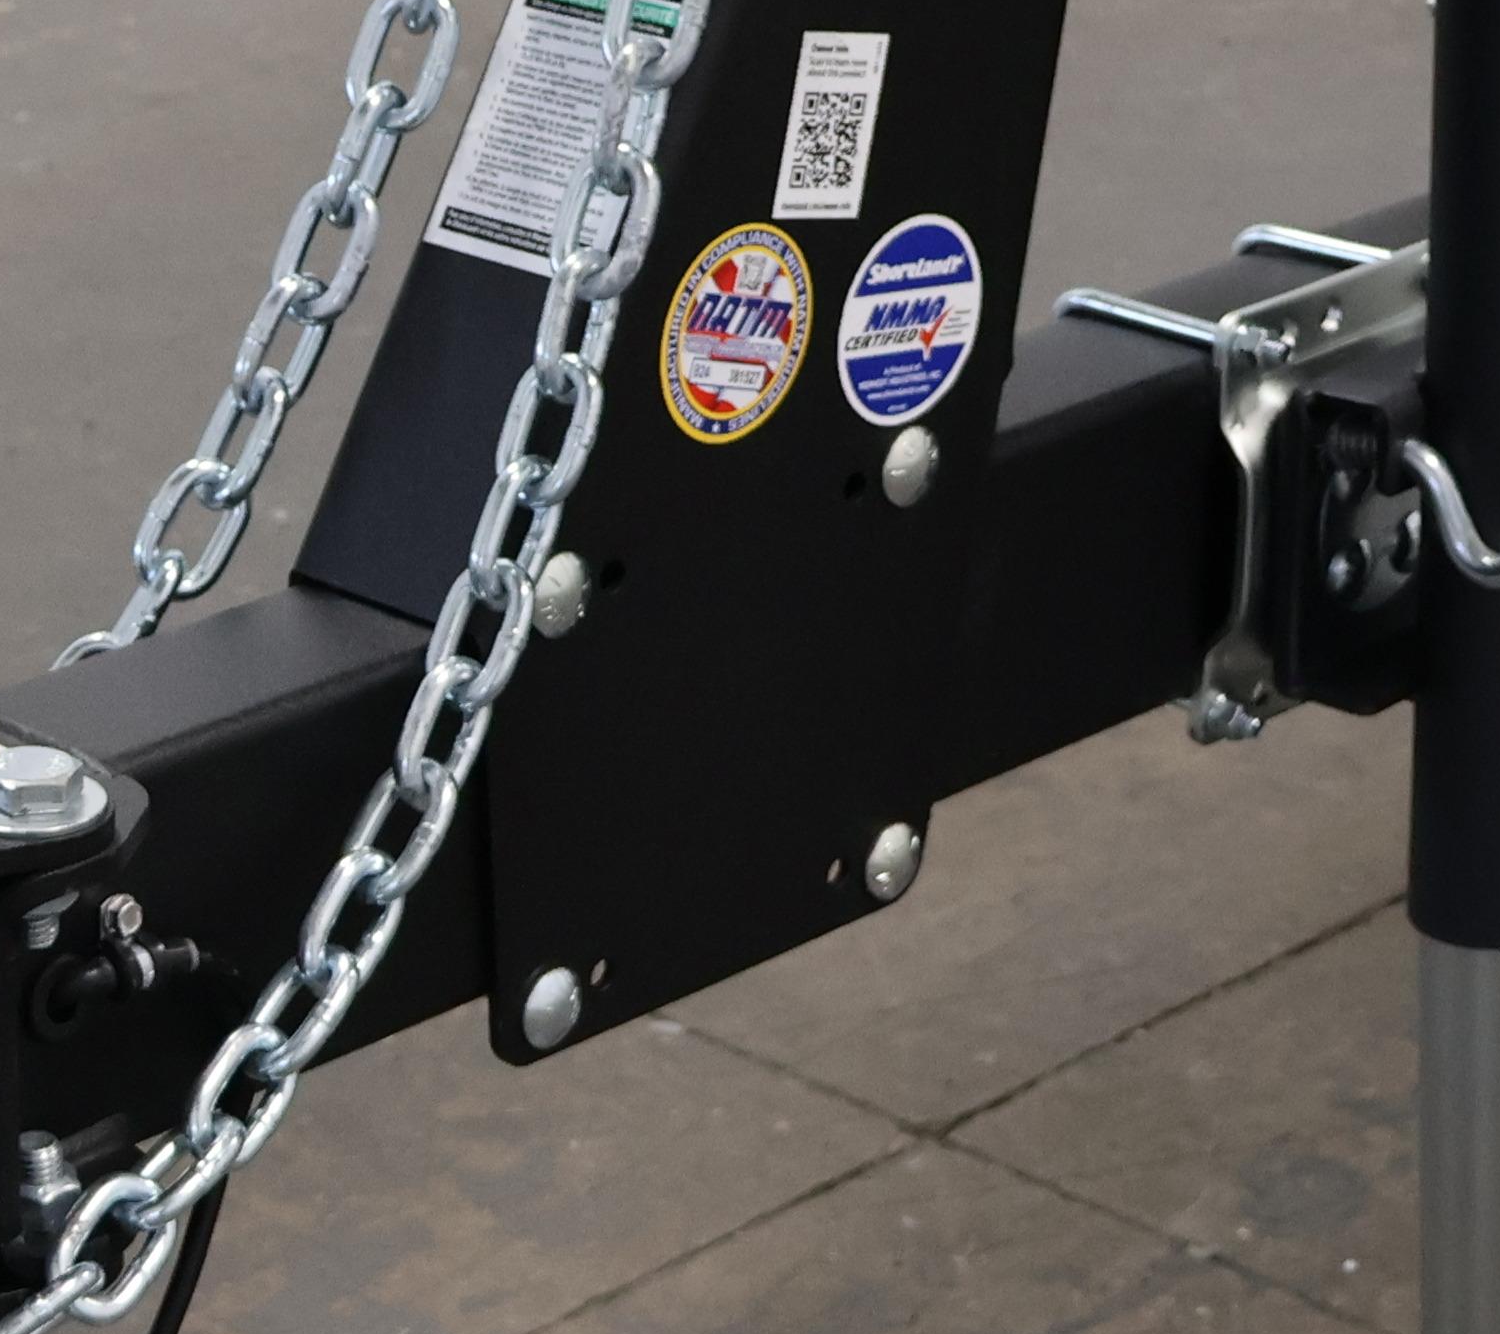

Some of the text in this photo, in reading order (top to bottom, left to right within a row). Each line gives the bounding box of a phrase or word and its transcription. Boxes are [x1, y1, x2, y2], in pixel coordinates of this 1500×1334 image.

[701, 231, 786, 271] COMPLIANCE
[864, 295, 946, 334] NMMA
[845, 328, 918, 352] CERTIFIED
